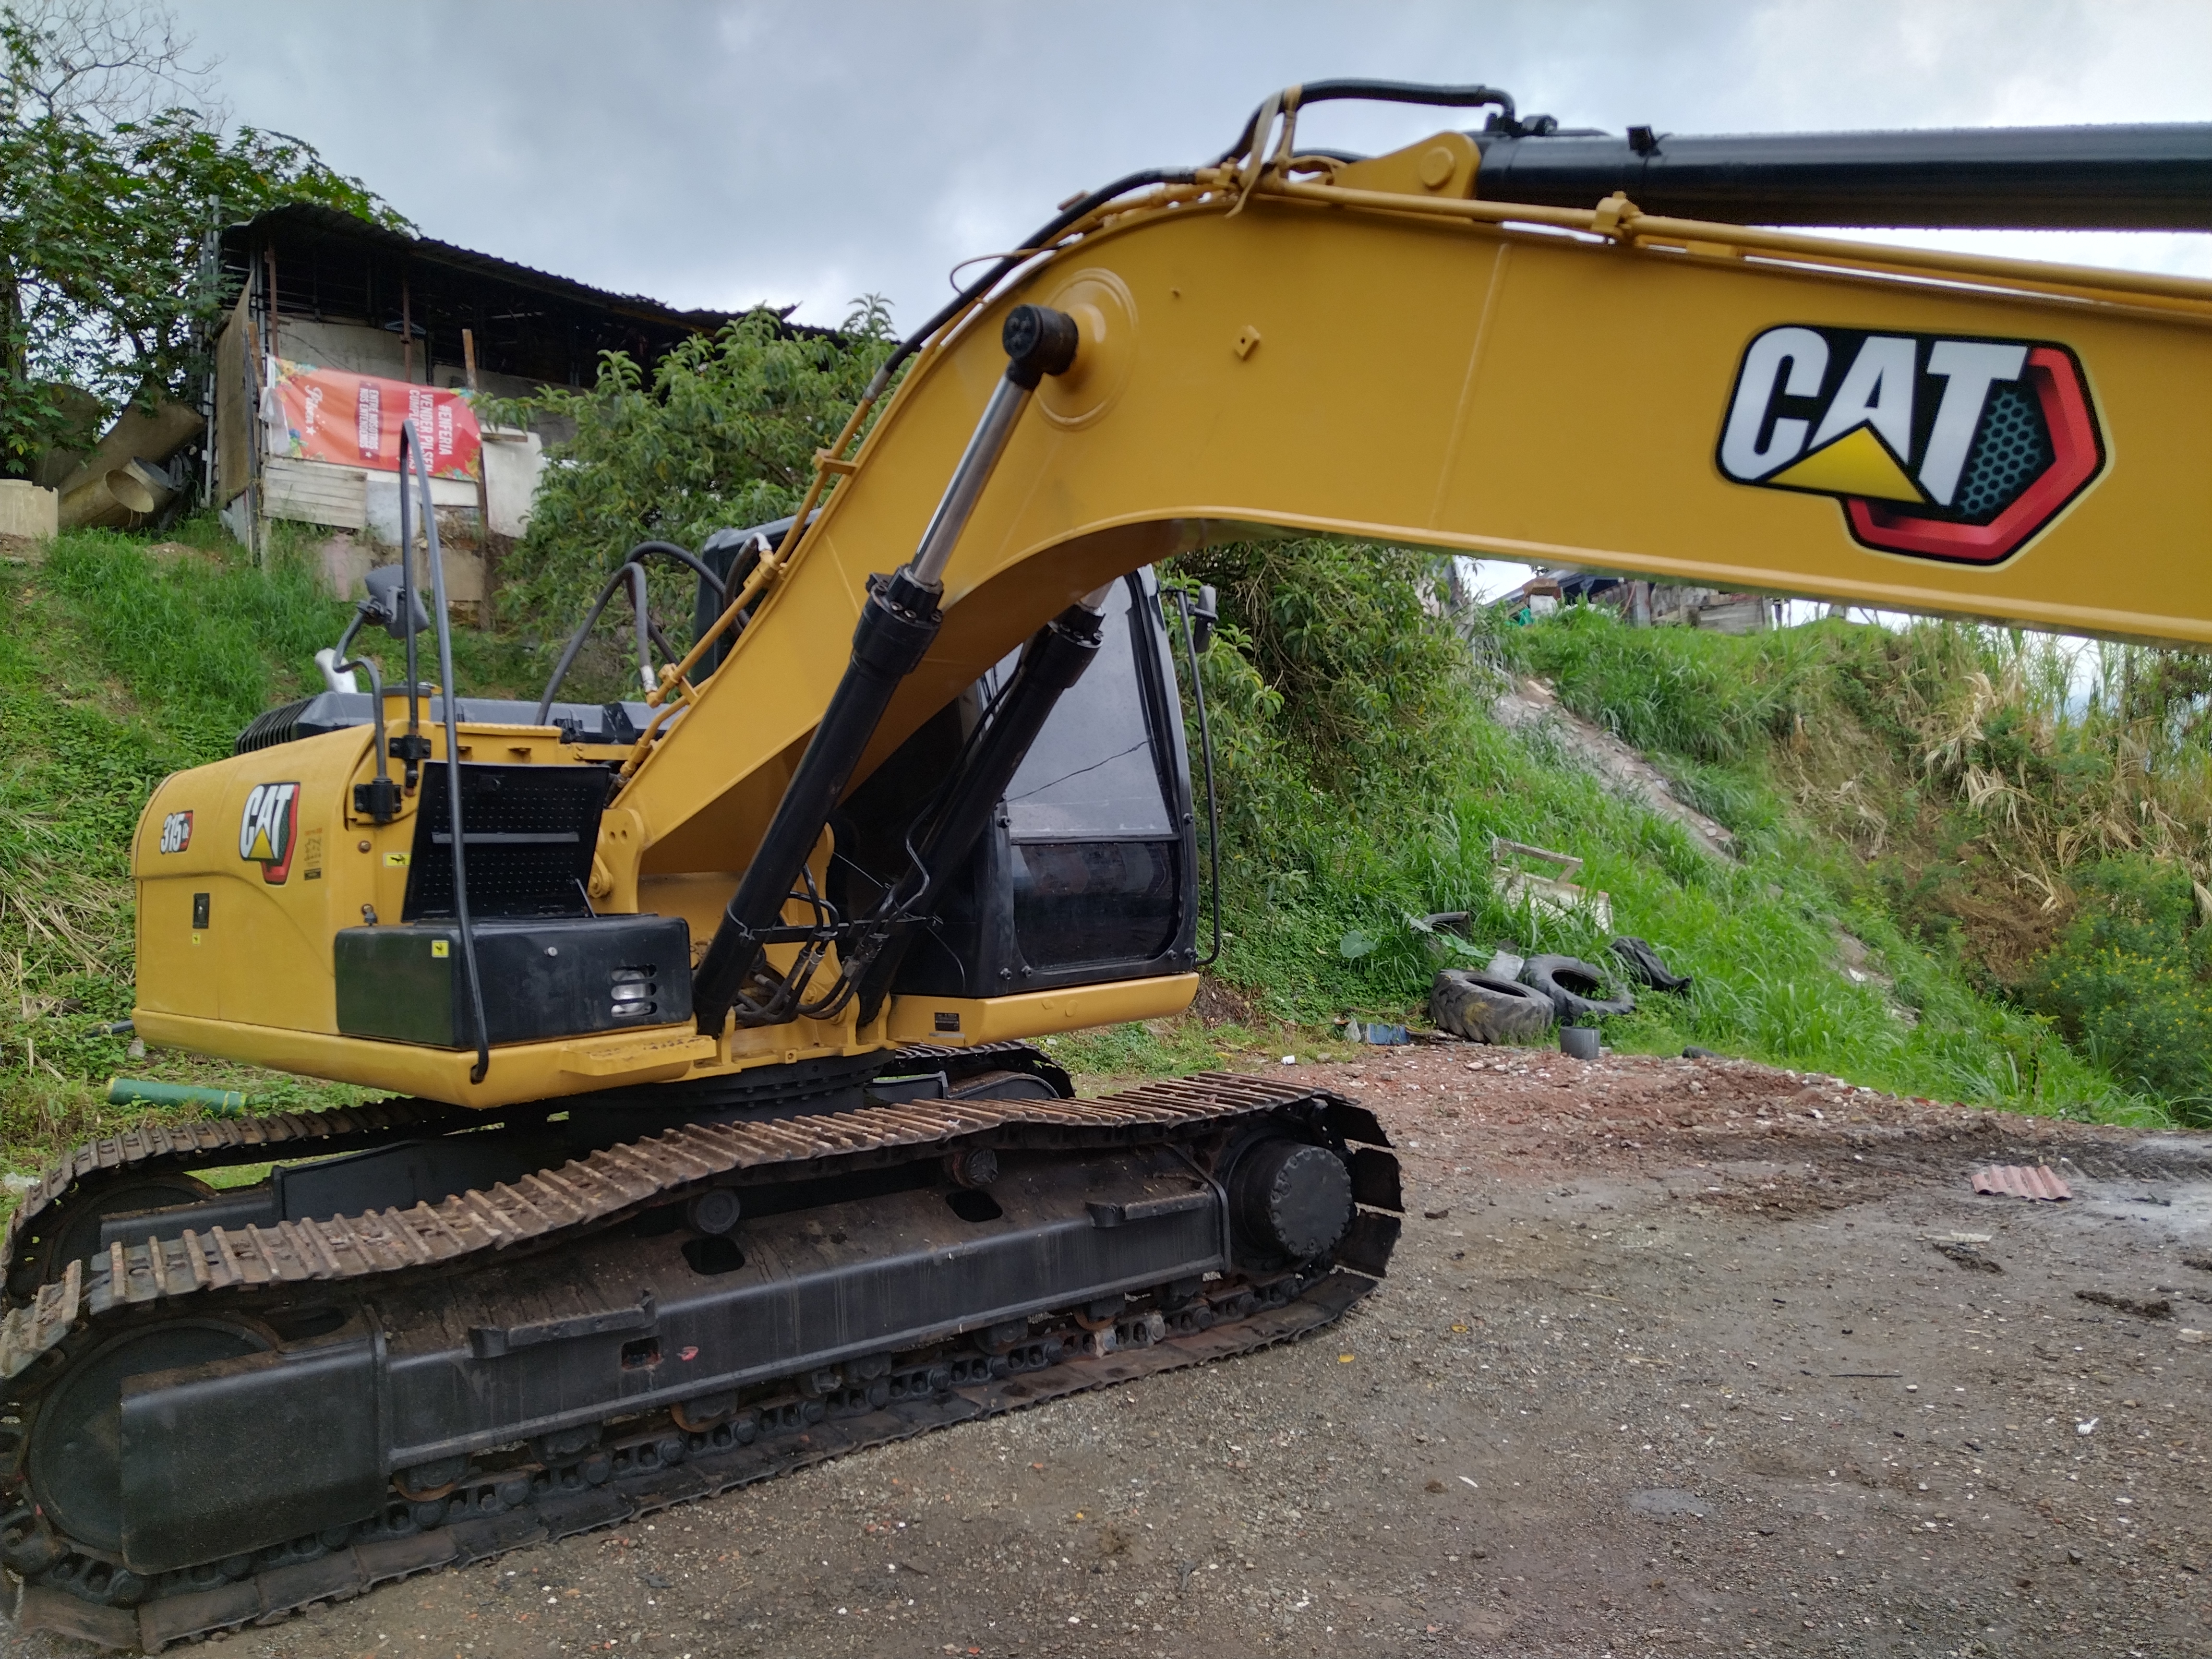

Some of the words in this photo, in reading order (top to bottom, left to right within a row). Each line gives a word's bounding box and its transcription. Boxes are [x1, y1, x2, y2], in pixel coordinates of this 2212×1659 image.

[304, 385, 323, 424] Pilsen
[360, 387, 369, 403] NOS
[369, 389, 379, 413] ENTRE
[420, 394, 434, 433] VENDER
[359, 403, 369, 449] ENTENDEMOS
[368, 413, 379, 450] NOSOTROS
[438, 405, 453, 455] #ENFERIA
[1721, 327, 2029, 506] CAT
[240, 784, 295, 859] CAT
